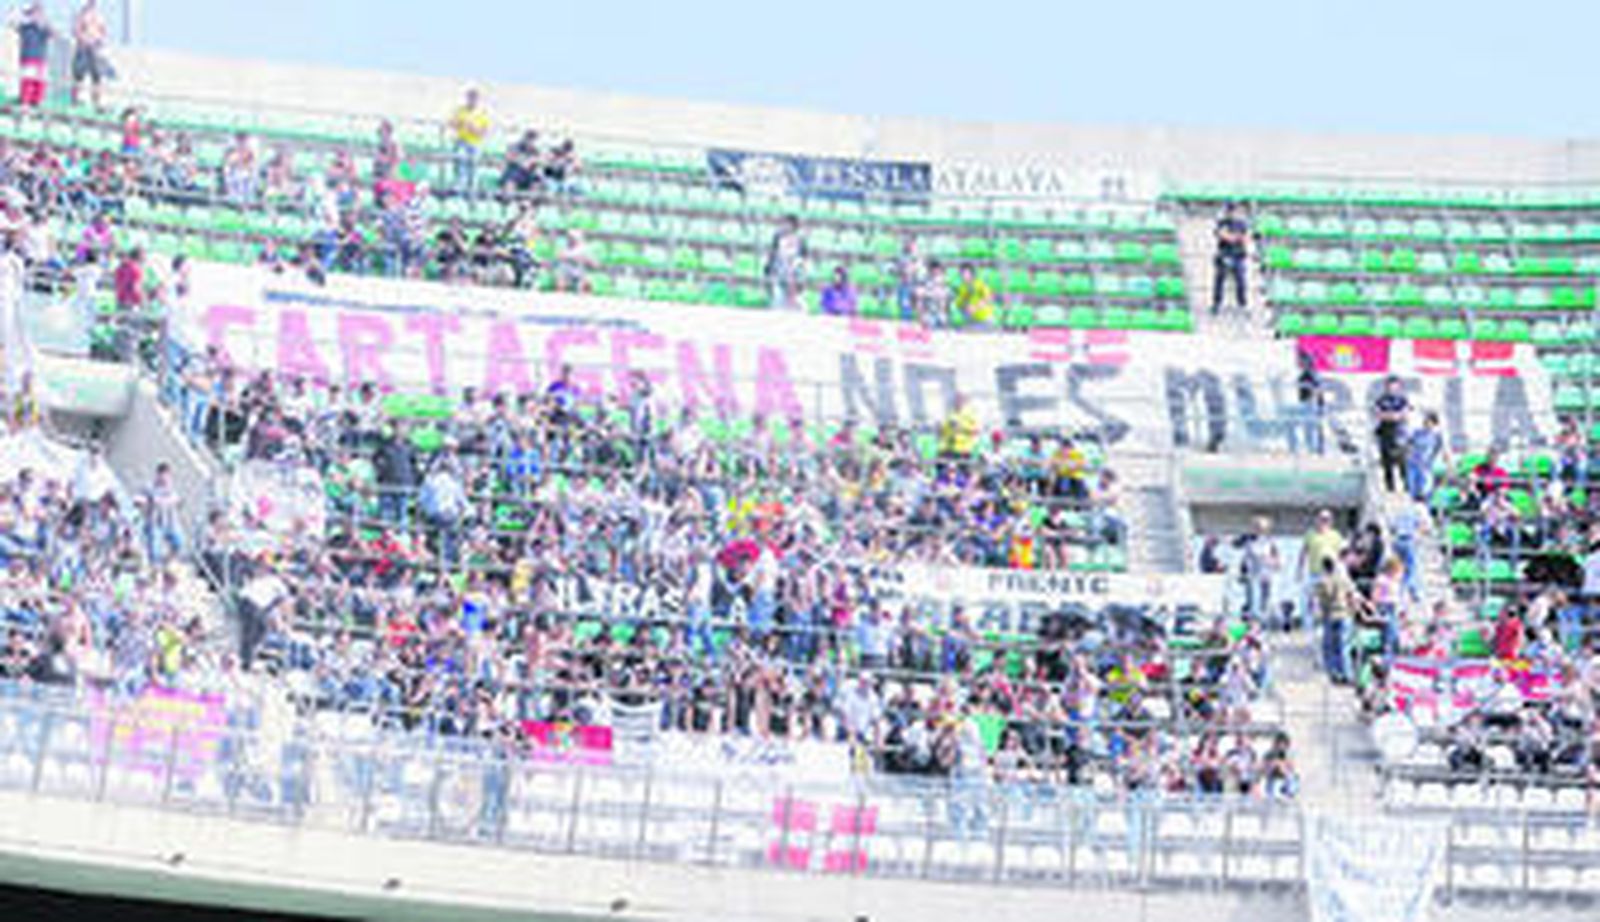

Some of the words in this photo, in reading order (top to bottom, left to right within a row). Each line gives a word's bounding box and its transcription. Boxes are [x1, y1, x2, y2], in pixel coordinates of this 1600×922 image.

[203, 304, 802, 418] CARTAGENA
[840, 352, 957, 428] NO
[995, 363, 1132, 443] ES
